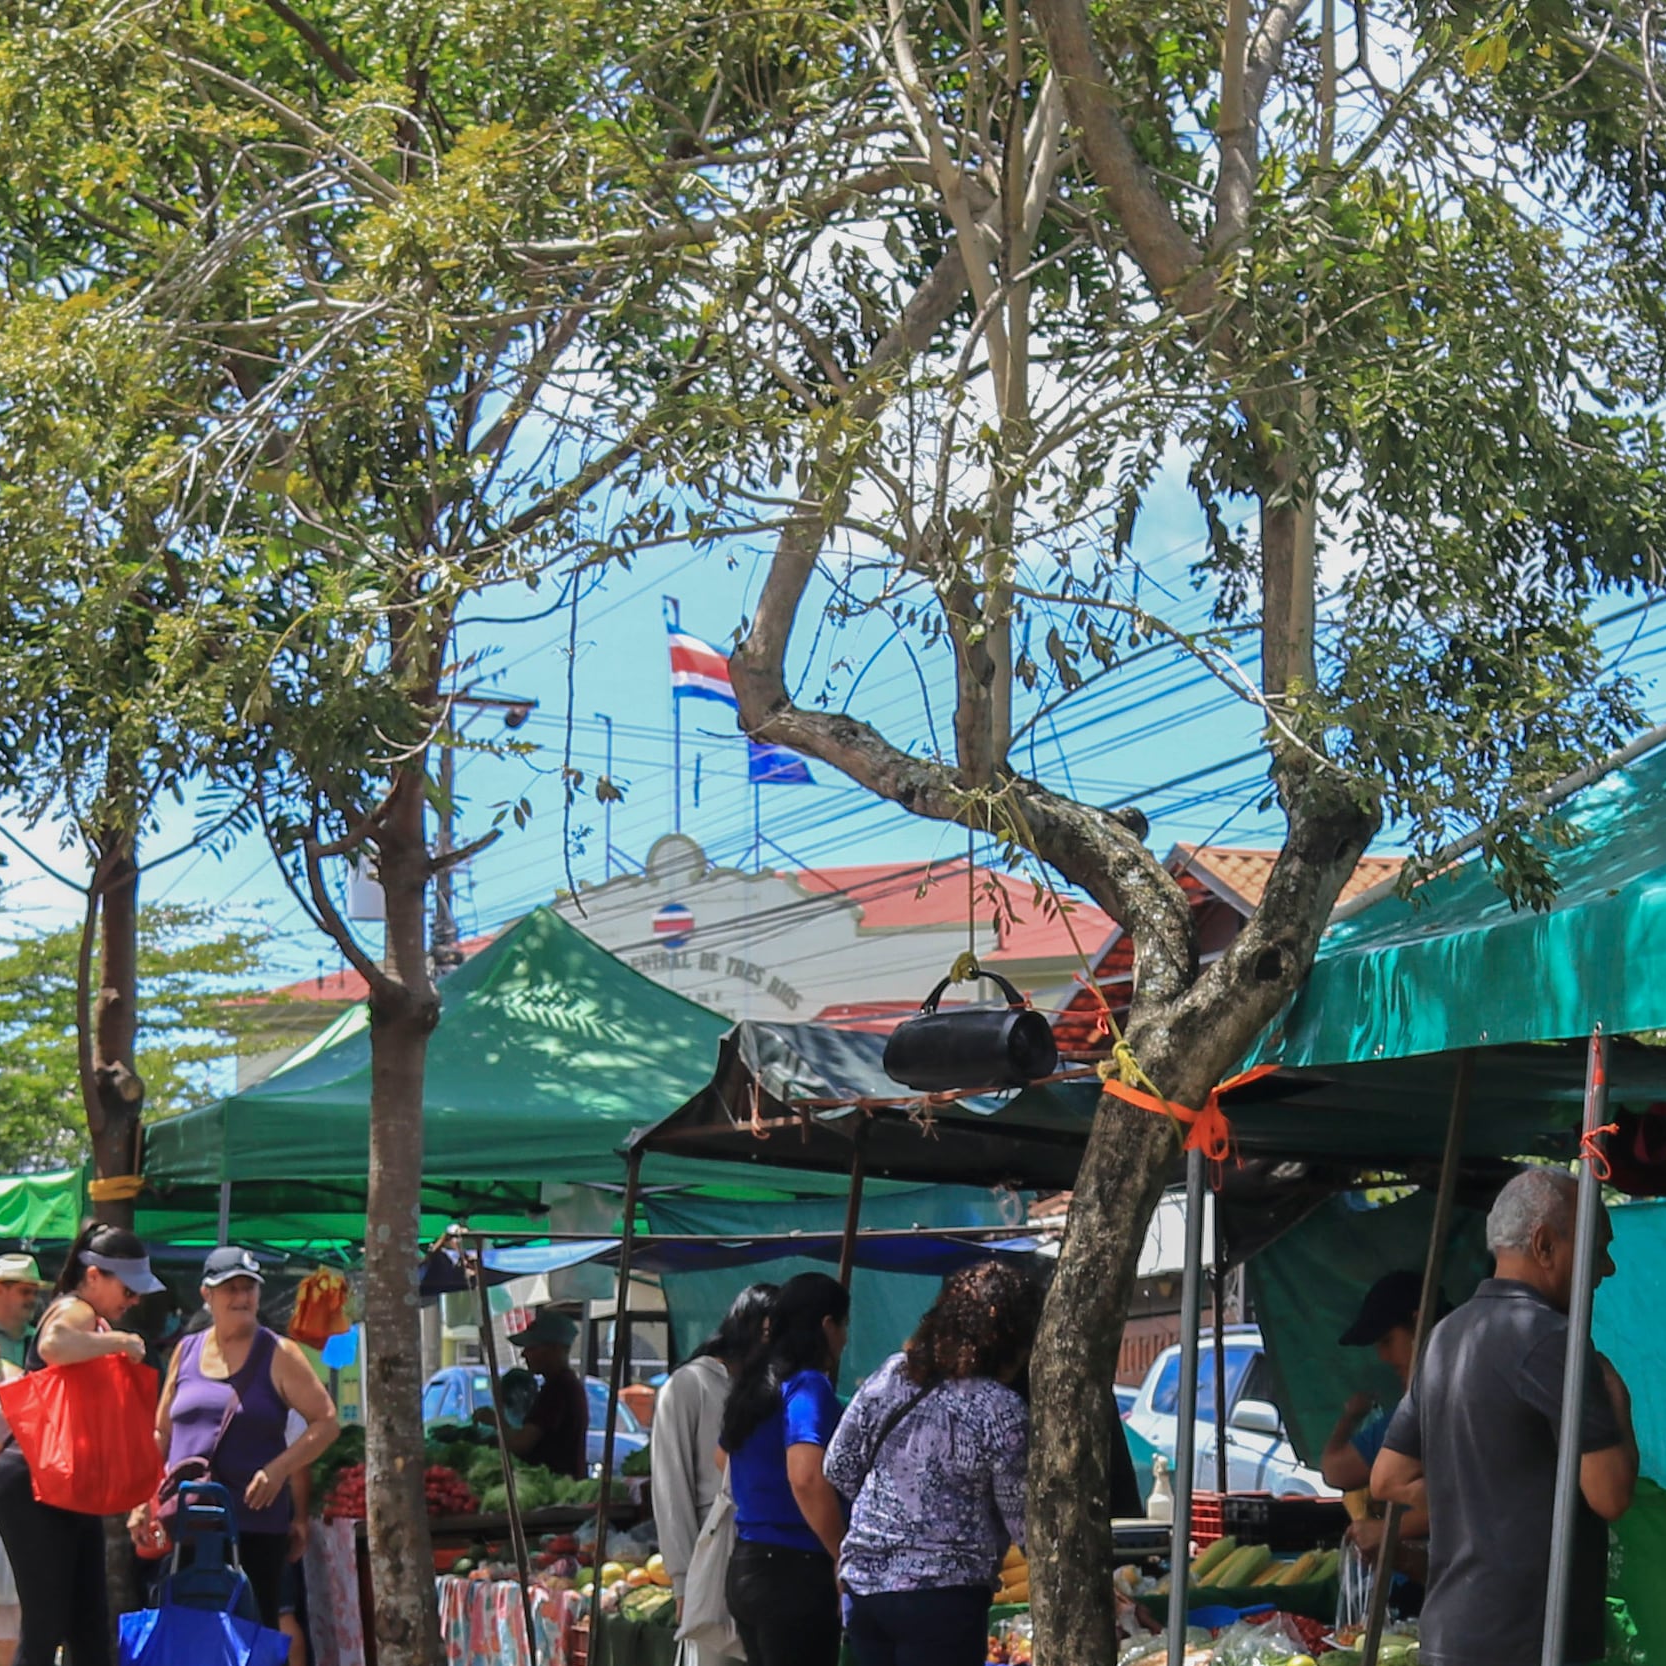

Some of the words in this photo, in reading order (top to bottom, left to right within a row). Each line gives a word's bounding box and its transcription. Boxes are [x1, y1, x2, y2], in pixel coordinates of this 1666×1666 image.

[630, 951, 692, 972] ENTRAL
[698, 952, 721, 972] DE
[725, 956, 766, 986] TRES
